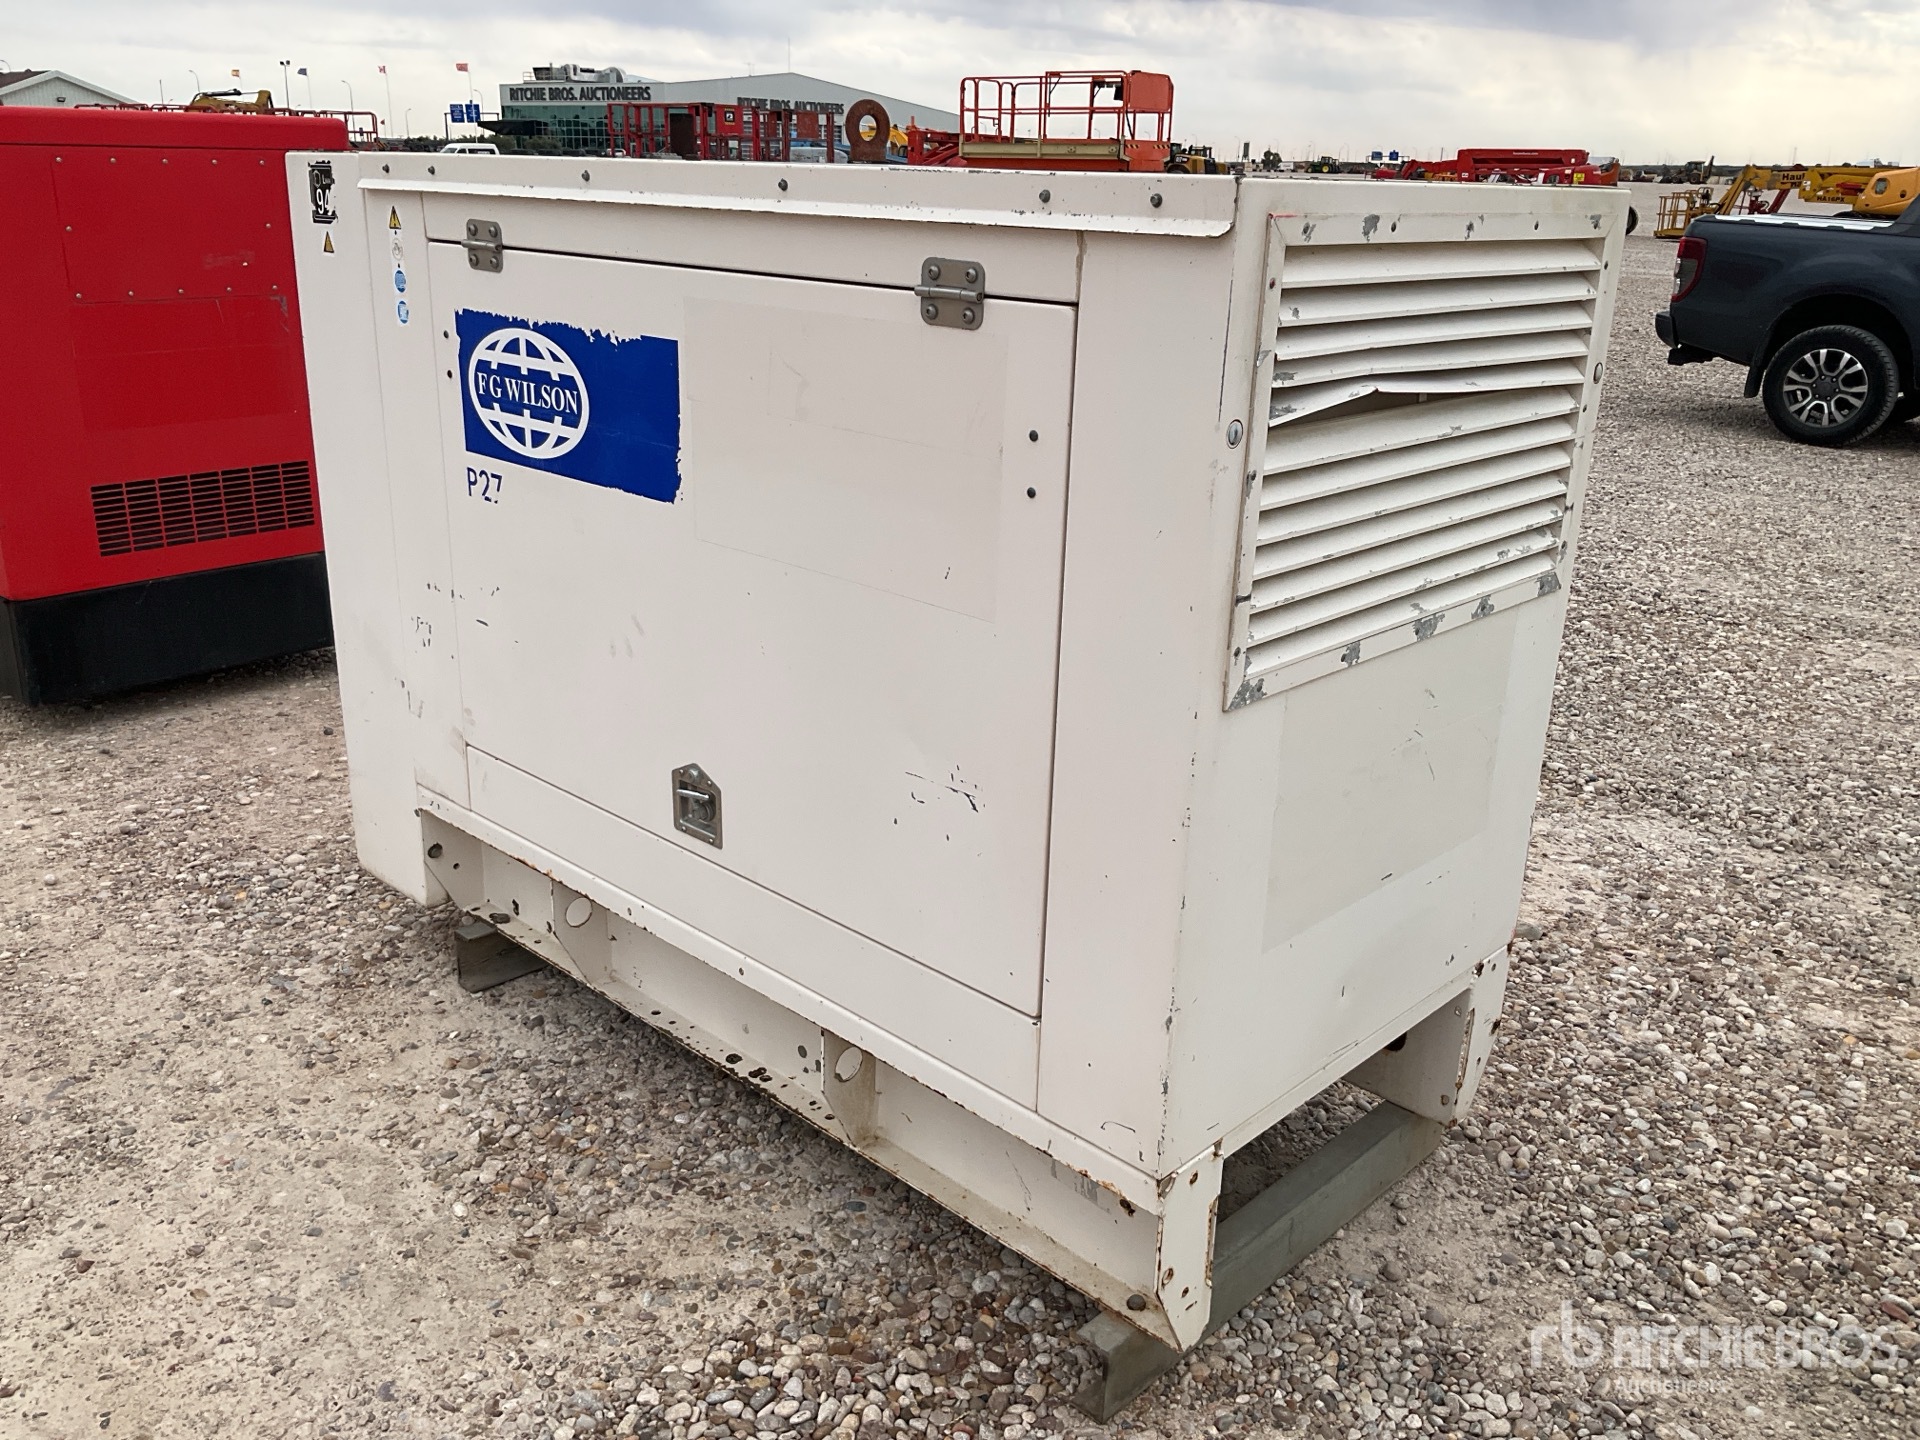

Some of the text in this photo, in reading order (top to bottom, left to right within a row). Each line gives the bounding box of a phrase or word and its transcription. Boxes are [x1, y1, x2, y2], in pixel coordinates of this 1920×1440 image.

[509, 86, 651, 101] RITCHIE BROS. AUCTIONEERS
[504, 376, 579, 415] WILSON
[466, 466, 503, 504] P27
